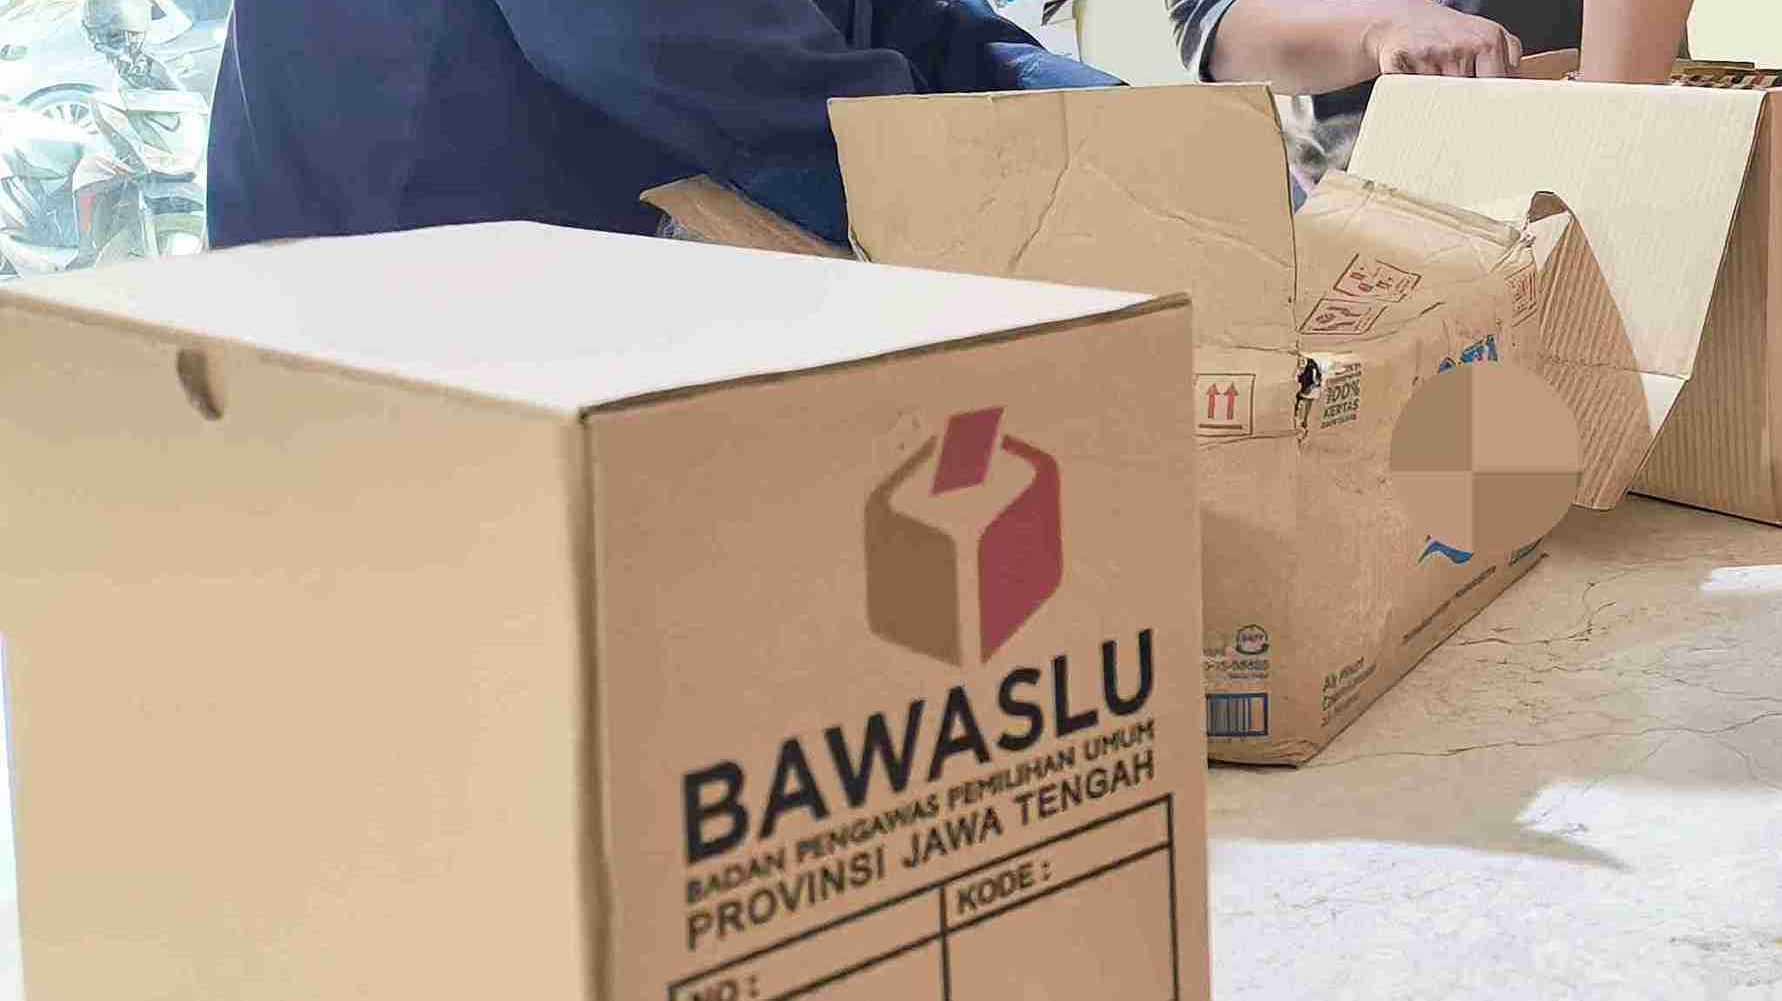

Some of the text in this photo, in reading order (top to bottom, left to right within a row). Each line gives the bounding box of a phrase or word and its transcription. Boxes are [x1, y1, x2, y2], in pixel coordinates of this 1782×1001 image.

[1322, 399, 1361, 421] KERTAS
[1325, 378, 1361, 405] 100%
[680, 628, 1156, 868] BAWASLU
[685, 718, 1156, 905] BADAN PENGAWAS PEMILIHAN UMUM
[685, 749, 1155, 952] PROVINSI JAWA TENGAH
[956, 862, 1036, 916] KODE
